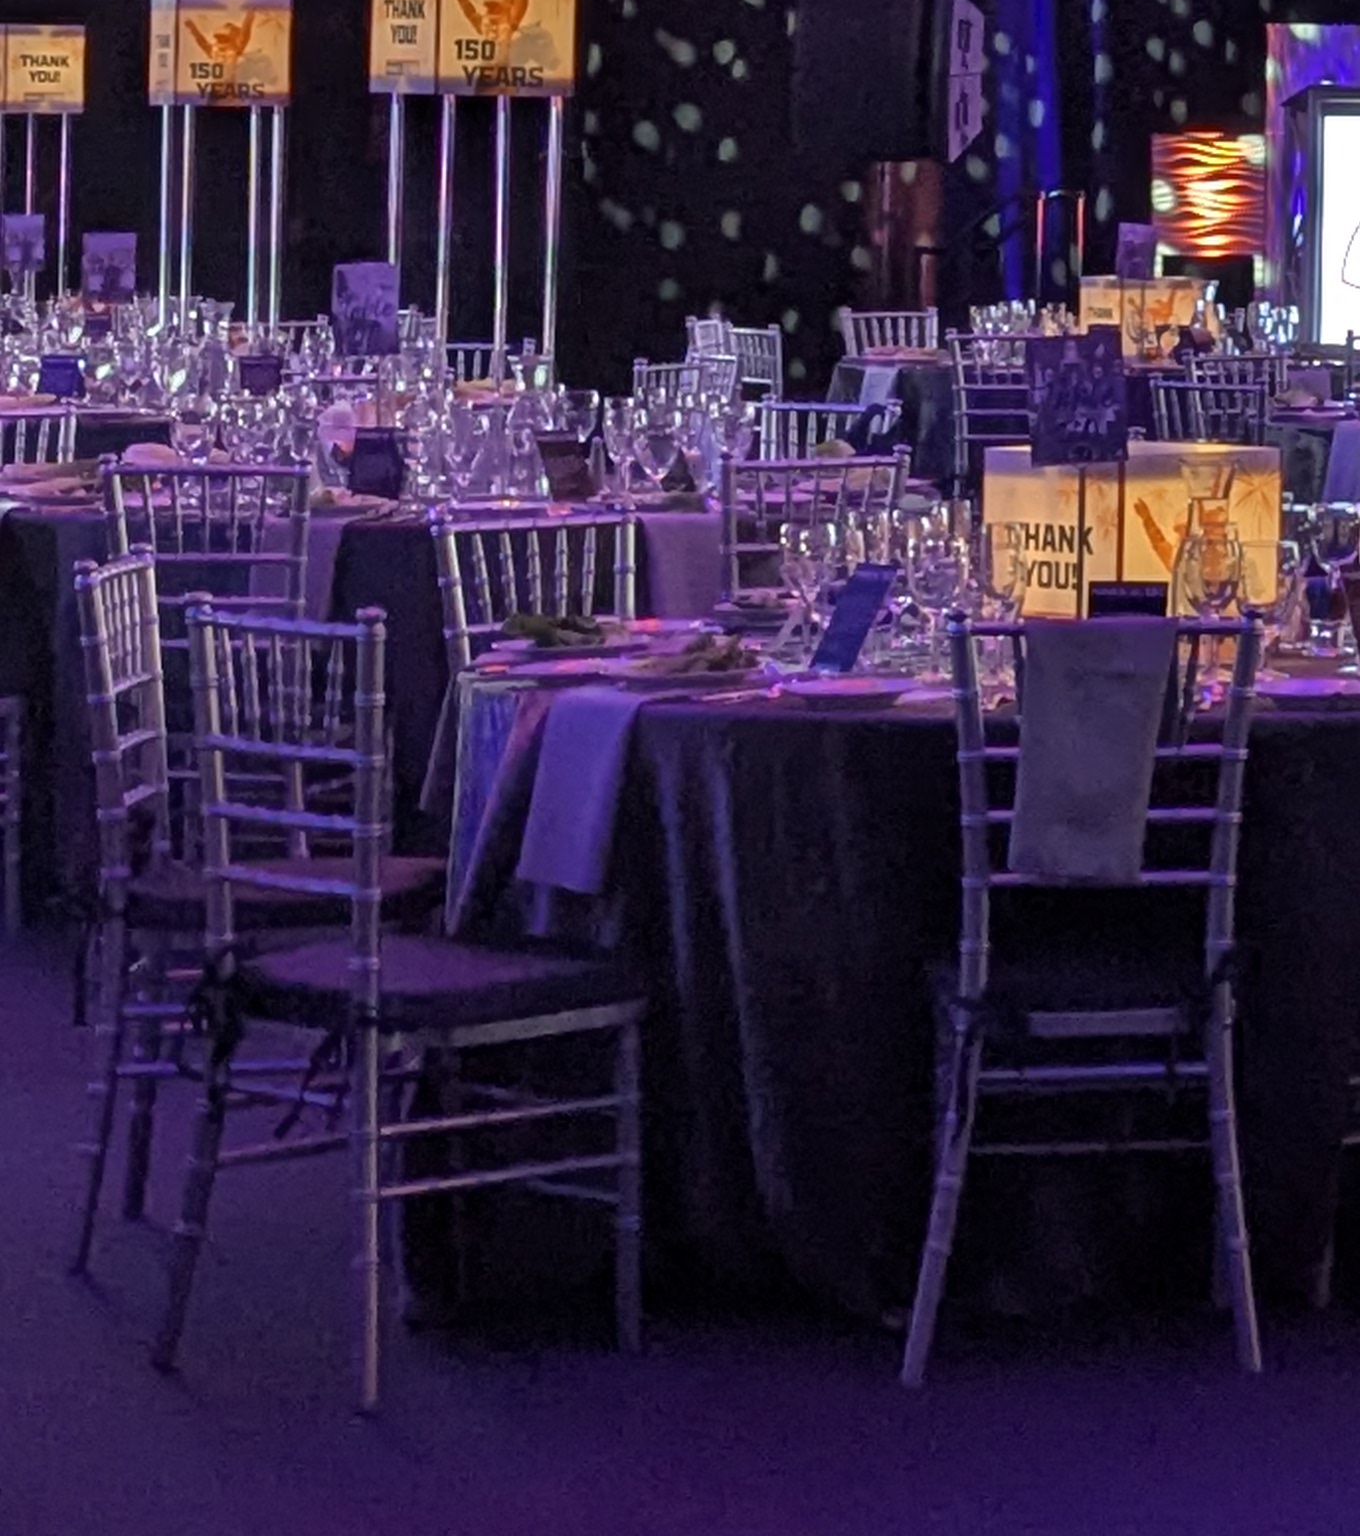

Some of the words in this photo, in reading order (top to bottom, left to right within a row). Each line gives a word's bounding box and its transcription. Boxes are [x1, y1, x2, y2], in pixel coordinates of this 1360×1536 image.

[391, 24, 417, 44] YOU!
[454, 38, 496, 61] 150
[19, 54, 69, 68] THANK
[29, 70, 61, 83] YOU!
[189, 62, 224, 80] 150
[462, 65, 544, 88] YEARS
[196, 82, 265, 100] YEARS
